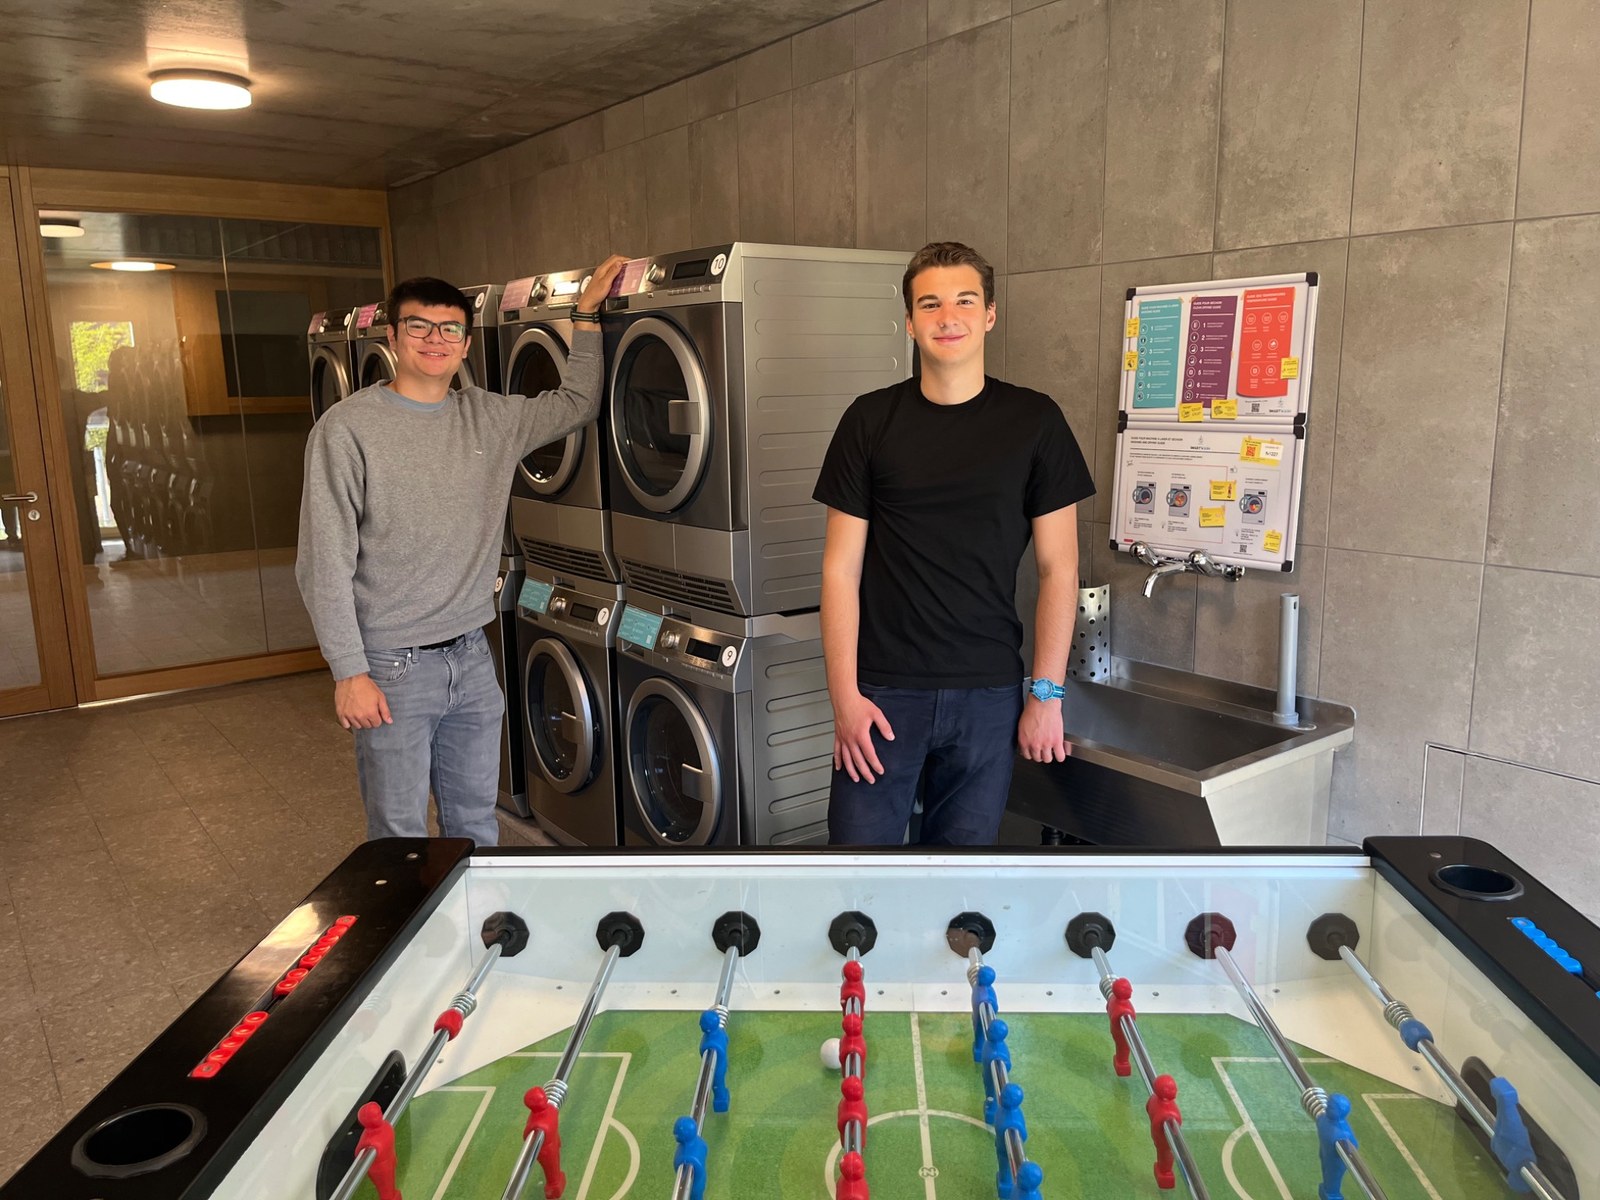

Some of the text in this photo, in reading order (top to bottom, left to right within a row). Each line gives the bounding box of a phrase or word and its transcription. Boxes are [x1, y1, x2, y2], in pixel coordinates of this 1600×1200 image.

[714, 258, 725, 270] 10
[601, 610, 607, 621] 7
[727, 650, 733, 661] 9
